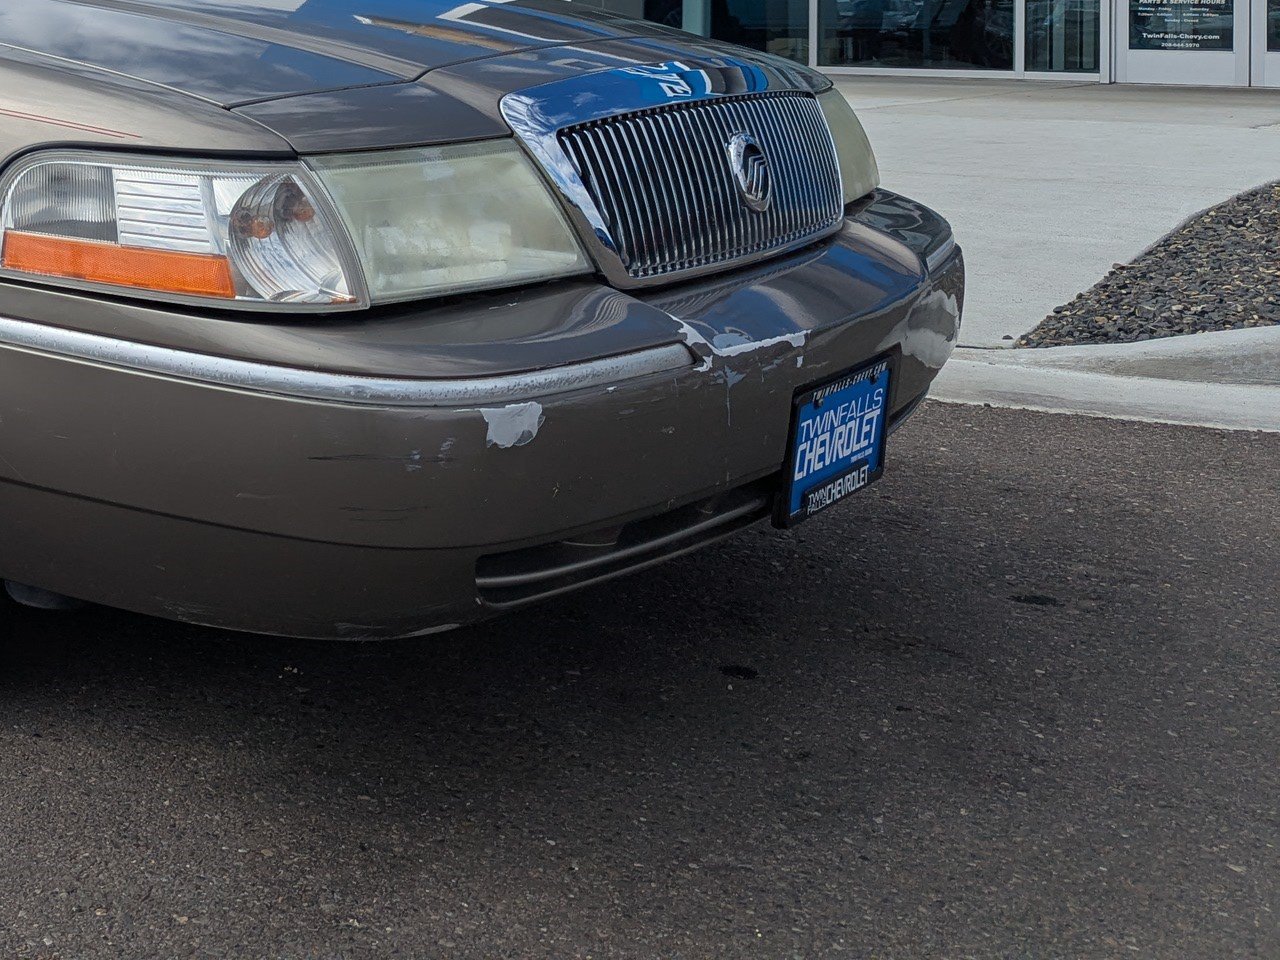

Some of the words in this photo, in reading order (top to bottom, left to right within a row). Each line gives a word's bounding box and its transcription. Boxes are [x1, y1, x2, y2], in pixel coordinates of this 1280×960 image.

[801, 388, 883, 442] TWINFALLS
[794, 408, 880, 481] CHEVROLET
[826, 464, 869, 505] CHEVROLET
